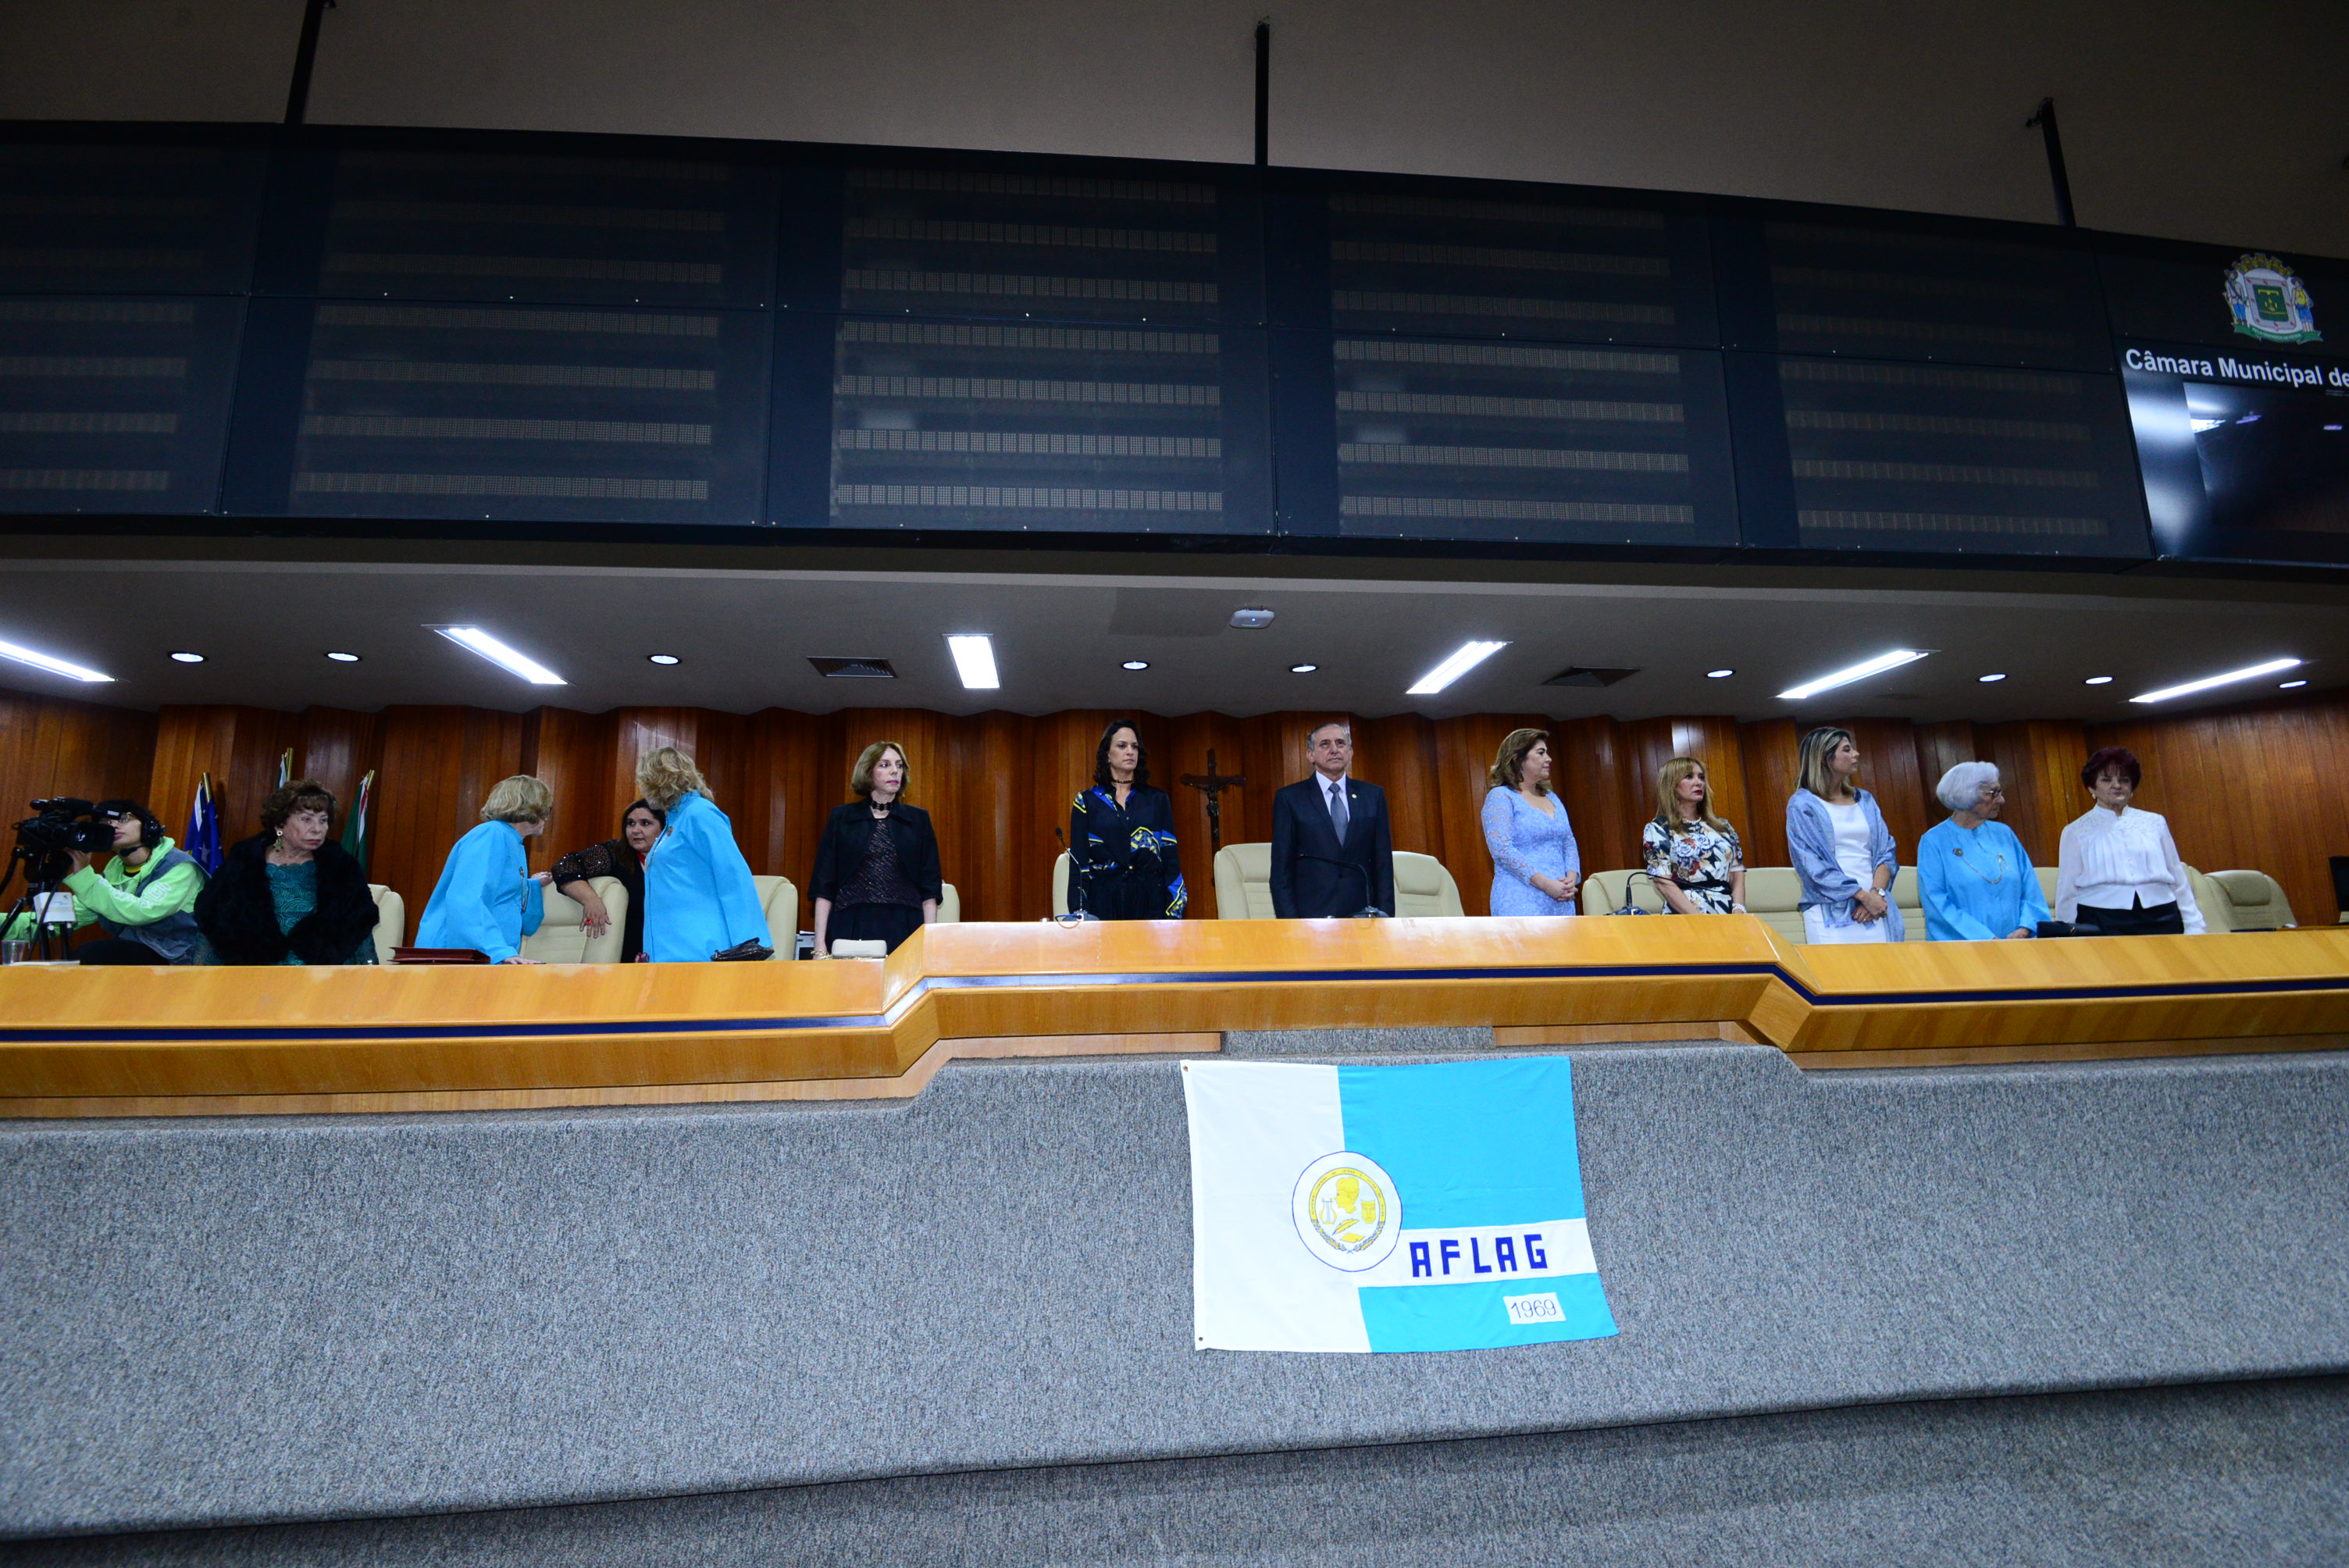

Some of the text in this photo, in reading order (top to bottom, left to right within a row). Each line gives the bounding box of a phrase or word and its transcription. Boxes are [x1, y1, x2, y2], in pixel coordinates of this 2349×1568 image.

[2126, 348, 2214, 376] Câmara
[2218, 357, 2323, 388] Municipal
[1409, 1234, 1548, 1278] AFLAG
[1510, 1299, 1556, 1319] 1969
